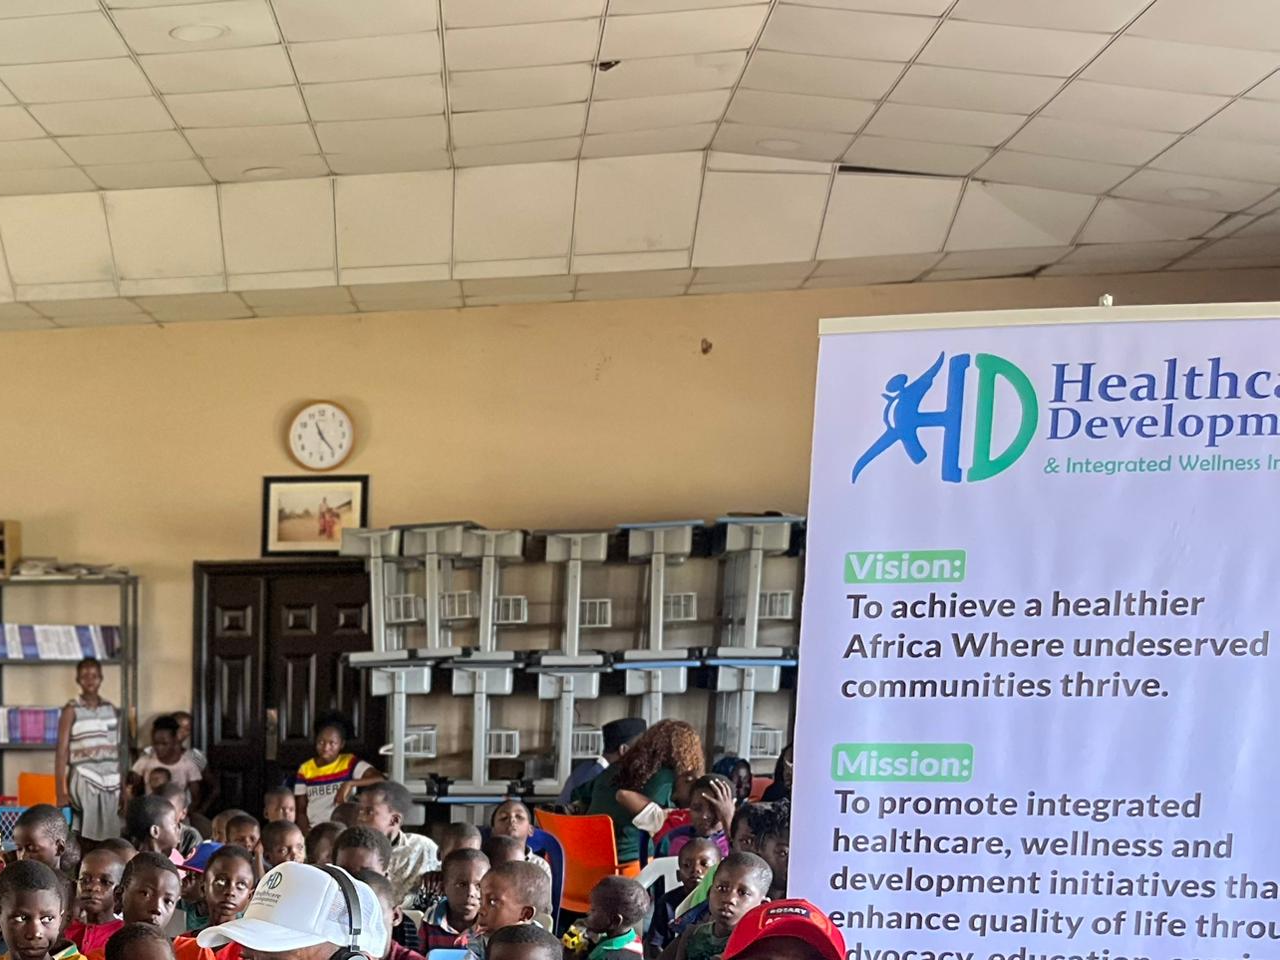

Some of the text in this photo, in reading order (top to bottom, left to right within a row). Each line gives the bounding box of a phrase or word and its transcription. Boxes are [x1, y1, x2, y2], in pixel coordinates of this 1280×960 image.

[1046, 403, 1280, 448] Developm
[1043, 457, 1059, 474] &
[1066, 455, 1171, 476] Integrated
[1178, 454, 1261, 473] Wellness
[848, 553, 962, 580] Vision:
[847, 590, 1205, 619] To achieve a healthier
[843, 631, 1269, 659] Africa Where undeserved
[841, 671, 1169, 698] communities thrive.
[837, 750, 970, 777] Mission:
[834, 789, 1202, 822] To promote integrated
[832, 828, 1233, 859] healthcare, wellness and
[829, 866, 1040, 898] development
[1049, 870, 1216, 899] initiatives
[829, 904, 960, 932] enhance
[968, 908, 1084, 938] quality
[1092, 911, 1126, 936] of
[1134, 911, 1186, 938] life
